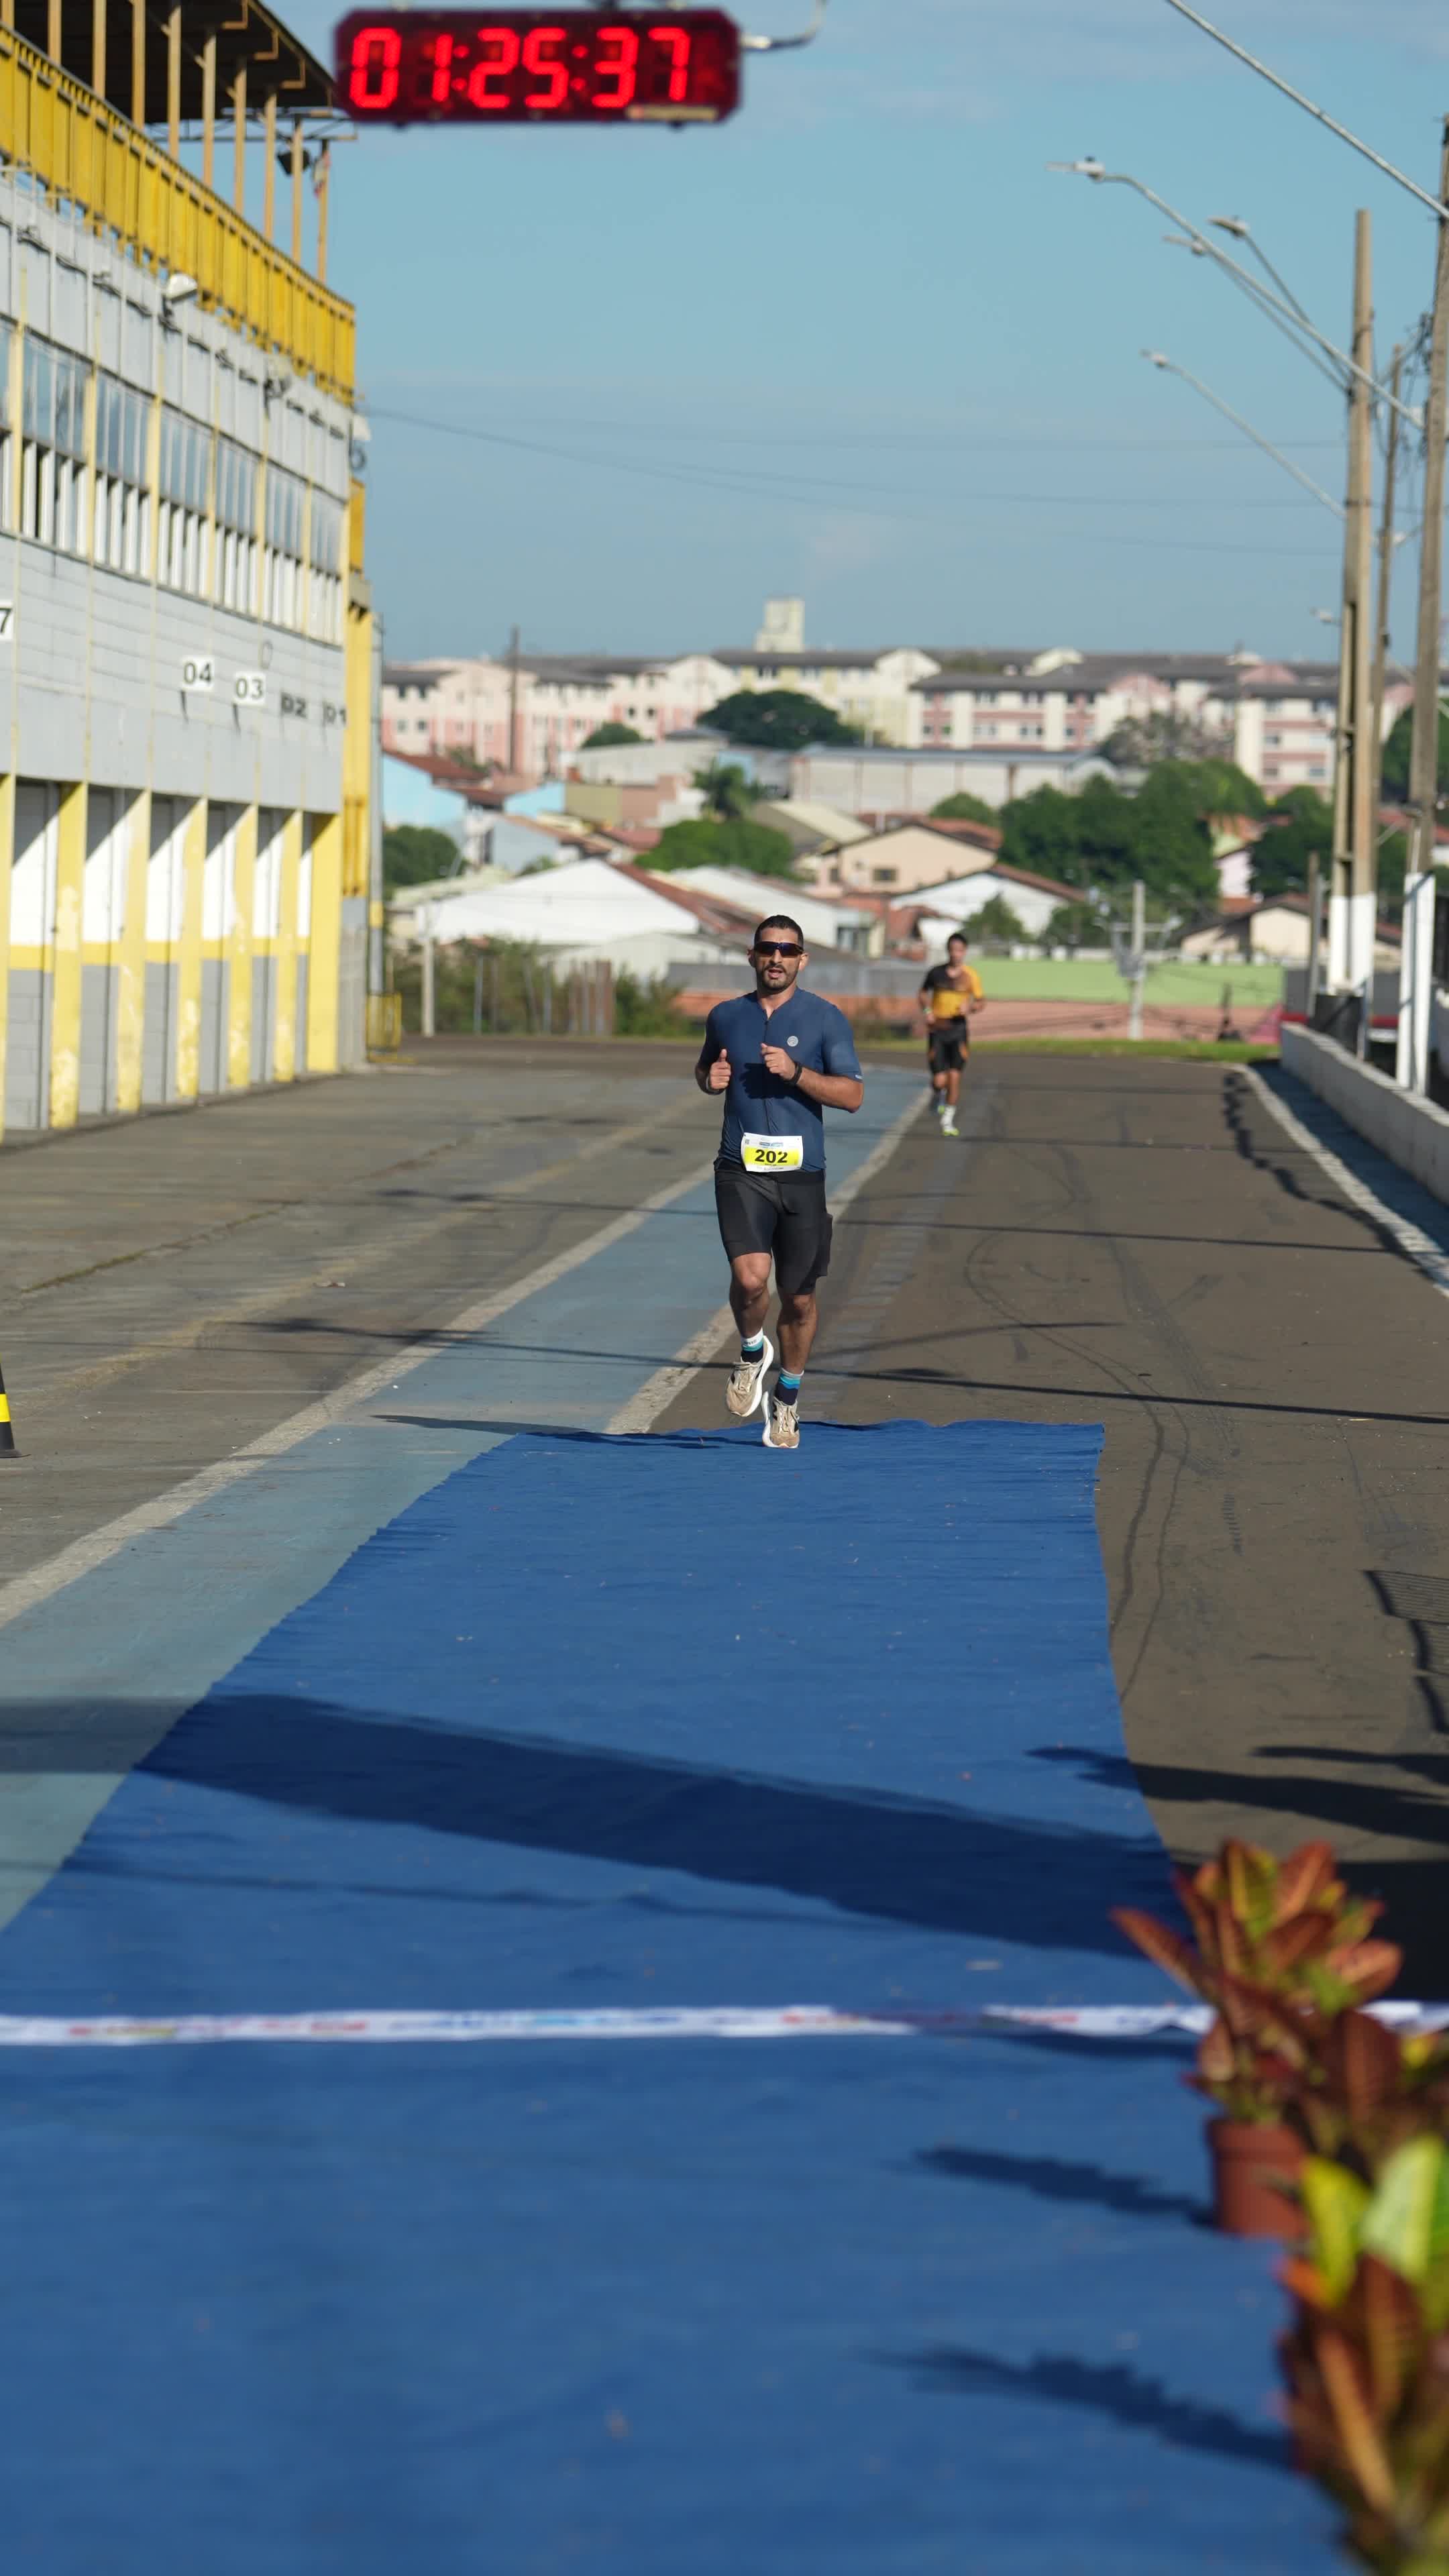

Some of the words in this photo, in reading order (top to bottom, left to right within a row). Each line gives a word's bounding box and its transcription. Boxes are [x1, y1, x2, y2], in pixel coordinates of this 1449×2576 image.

[348, 28, 690, 108] 01:25:37
[183, 662, 211, 684] 04
[235, 677, 264, 699] 03
[755, 1149, 788, 1163] 202
